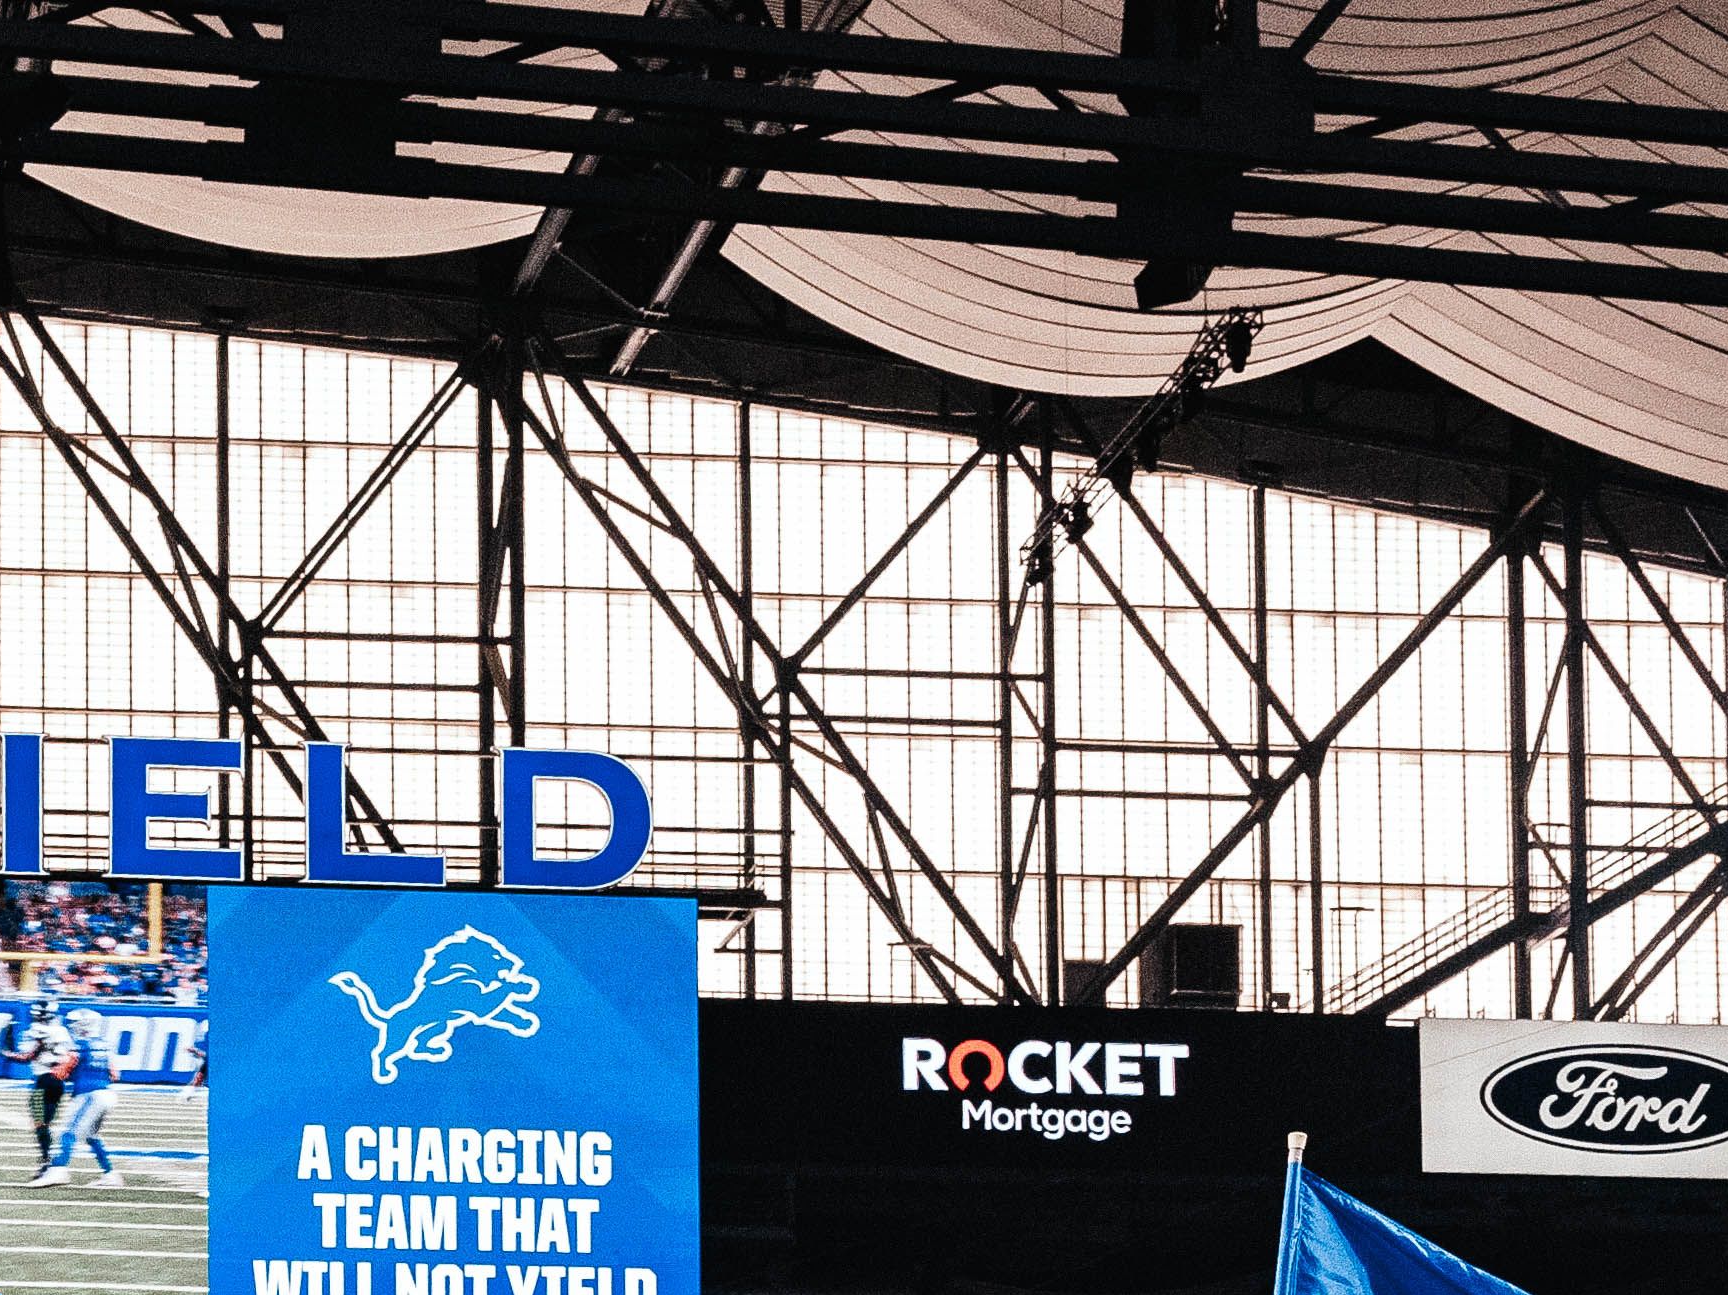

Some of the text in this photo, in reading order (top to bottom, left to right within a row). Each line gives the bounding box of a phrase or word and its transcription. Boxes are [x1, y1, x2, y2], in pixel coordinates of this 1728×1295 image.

[902, 1037, 1189, 1097] ROCKET
[1538, 1058, 1706, 1136] Ford
[962, 1099, 1132, 1142] Mortgage
[297, 1124, 612, 1186] A CHARGING
[313, 1192, 600, 1254] TEAM THAT
